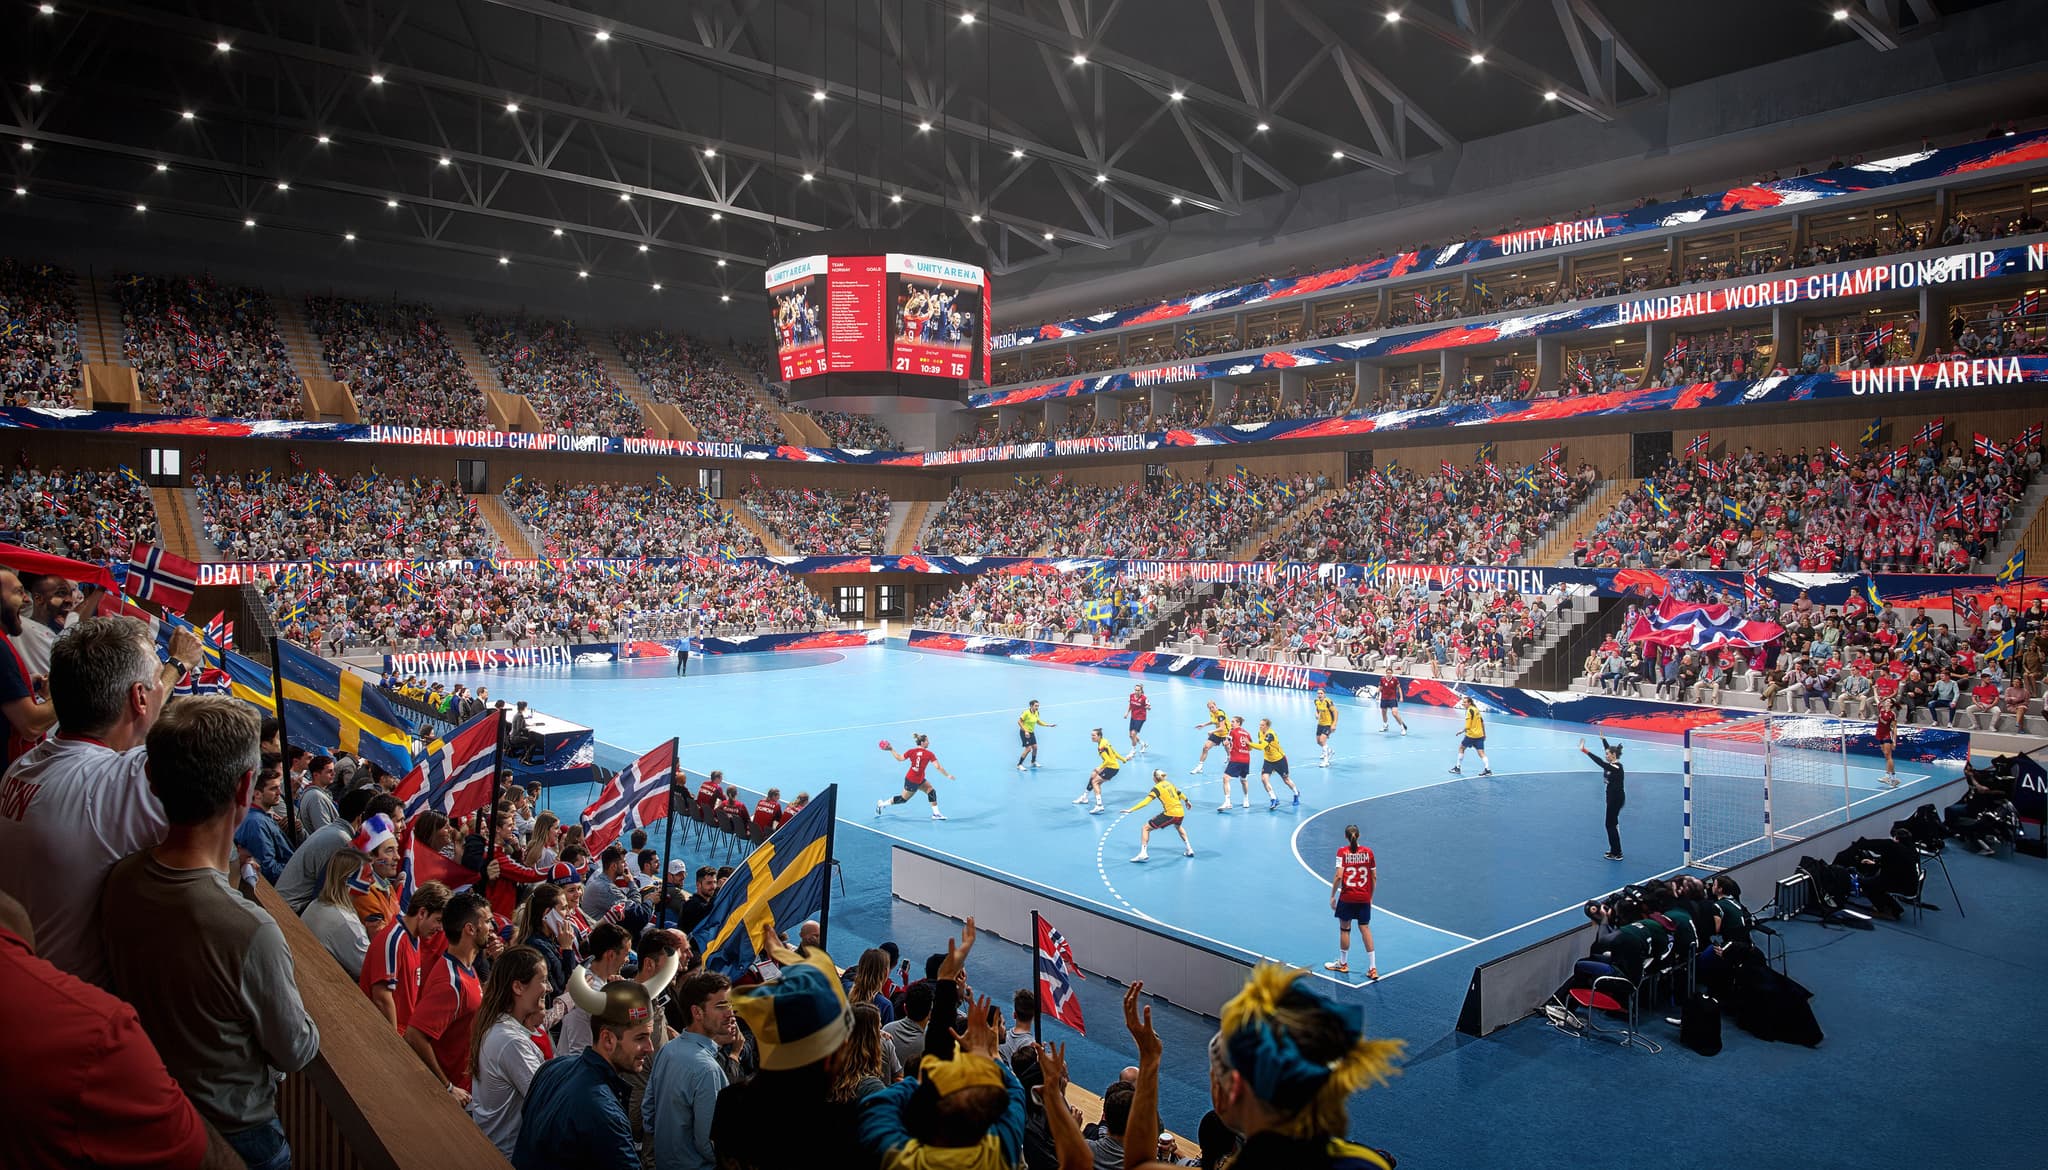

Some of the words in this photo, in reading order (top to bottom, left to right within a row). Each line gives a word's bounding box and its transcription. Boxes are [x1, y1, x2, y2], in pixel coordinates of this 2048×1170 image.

[1502, 229, 1547, 256] UNITY
[1552, 218, 1605, 247] ARENA
[917, 262, 942, 274] UNITY
[944, 266, 977, 280] ARENA
[1618, 290, 1716, 324] HANDBALL
[1724, 278, 1798, 310] WORLD
[2028, 243, 2048, 272] N
[990, 332, 1017, 351] SWEDEN
[784, 365, 794, 378] 21
[817, 358, 827, 371] 15
[896, 357, 910, 371] 21
[921, 364, 941, 374] 10:39
[951, 362, 964, 376] 15
[1134, 368, 1162, 388] UNITY
[1165, 364, 1197, 384] ARENA
[1851, 363, 1925, 395] UNITY
[1934, 356, 2024, 389] ARENA
[370, 425, 449, 446] HANDBALL
[454, 429, 504, 448] WORLD
[623, 438, 674, 456] NORWAY
[678, 440, 693, 456] VS
[697, 441, 742, 459] SWEDEN
[924, 450, 960, 465] HANDBALL
[960, 447, 986, 463] WORLD
[1055, 438, 1091, 457] NORWAY
[1093, 436, 1105, 453] VS
[1107, 434, 1146, 451] SWEDEN
[1190, 562, 1234, 584] WORLD
[1468, 567, 1543, 595] SWEDEN
[391, 650, 468, 675] NORWAY
[475, 648, 498, 670] VS
[504, 645, 571, 668] SWEDEN
[1223, 660, 1263, 685] UNITY
[1264, 665, 1310, 689] ARENA
[1345, 866, 1368, 888] 23
